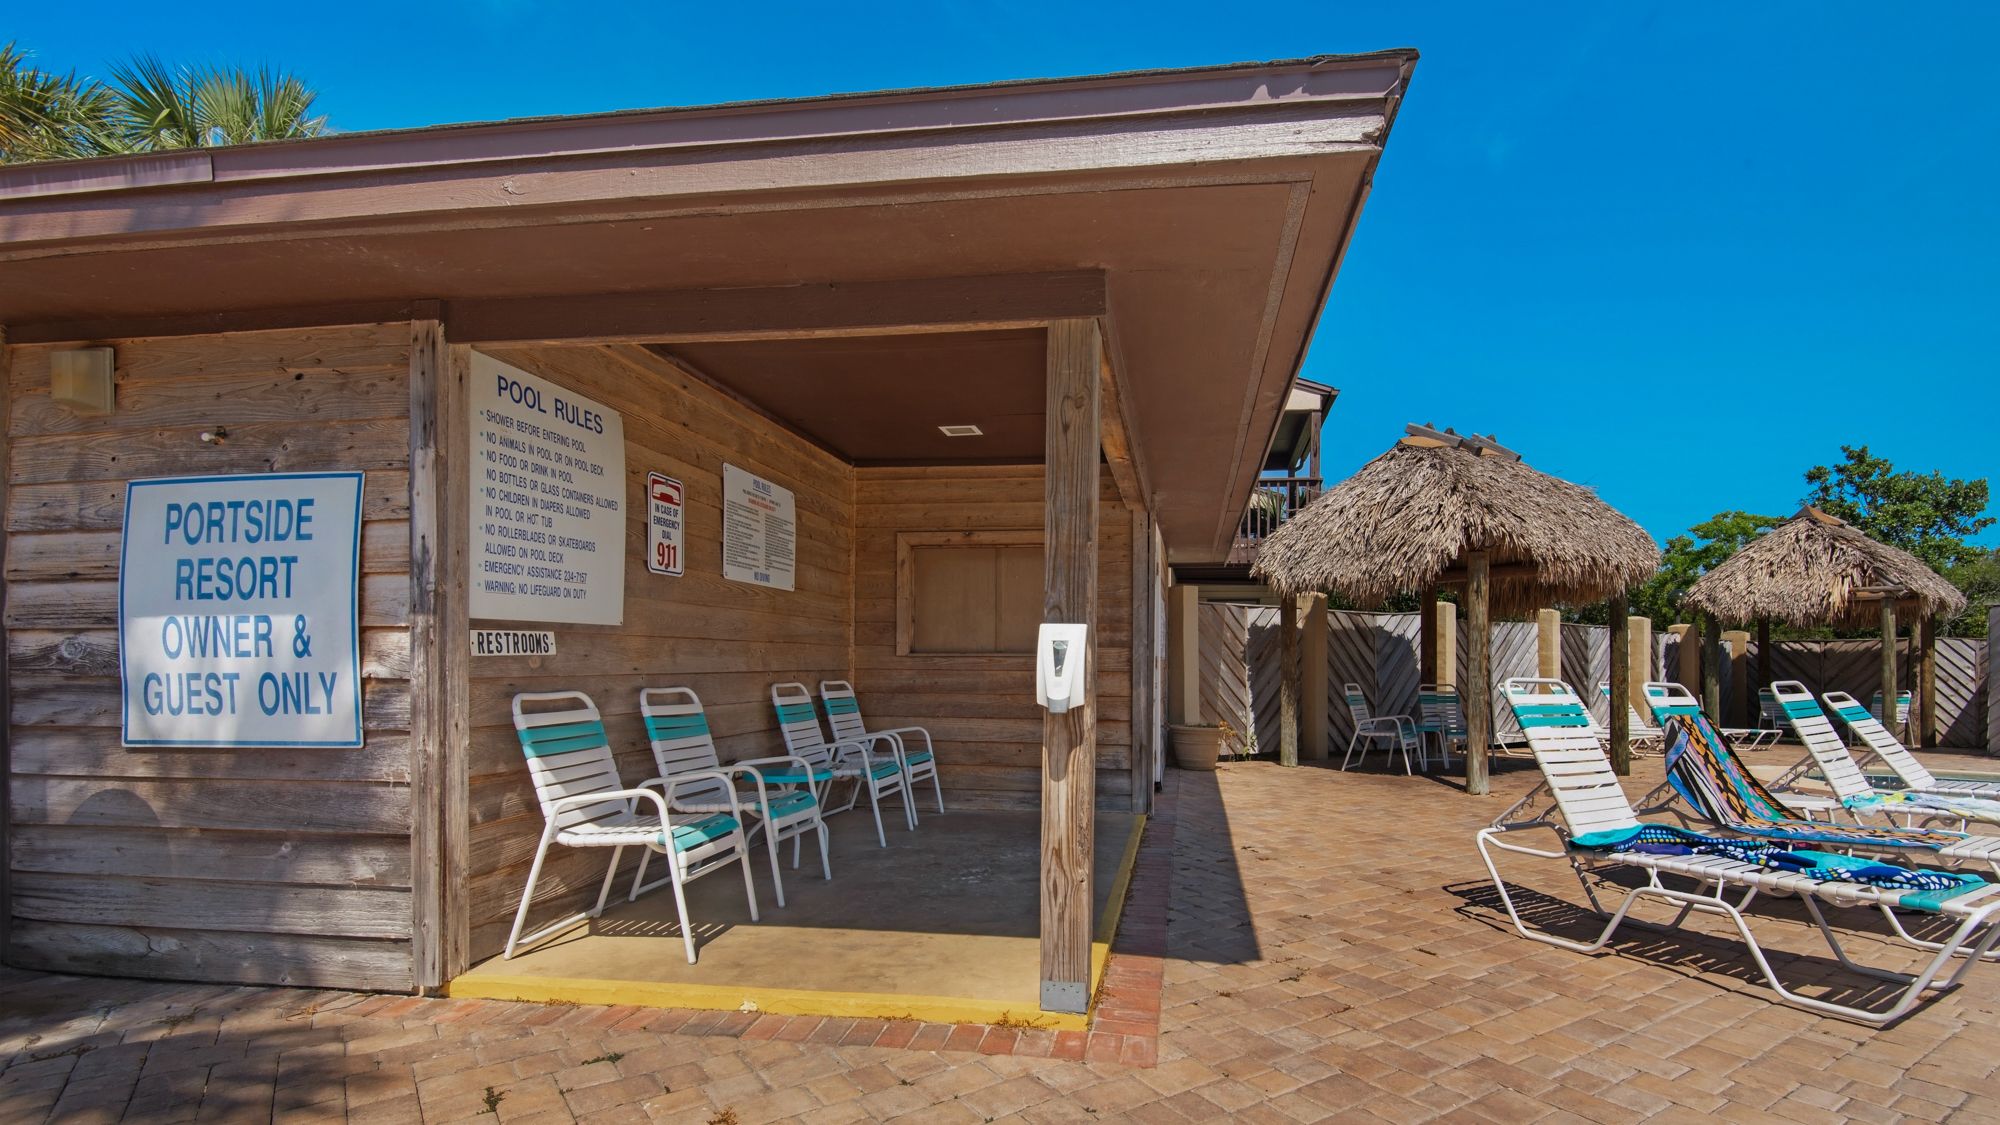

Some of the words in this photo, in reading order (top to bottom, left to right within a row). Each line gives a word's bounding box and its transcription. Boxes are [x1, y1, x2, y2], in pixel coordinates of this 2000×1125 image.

[497, 375, 546, 414] POOL
[554, 398, 603, 434] RULES
[486, 410, 514, 430] SHOWER
[516, 420, 540, 438] BEFORE
[542, 429, 570, 448] ENTERING
[572, 439, 586, 452] POOL
[486, 432, 496, 444] NO
[499, 436, 526, 454] ANIMALS
[528, 444, 534, 455] IN
[536, 446, 552, 462] POOL
[554, 452, 562, 465] OR
[565, 456, 573, 468] ON
[574, 458, 588, 472] POOL
[590, 464, 604, 477] DECK
[486, 450, 496, 462] NO
[500, 453, 517, 468] FOOD
[520, 459, 528, 470] OR
[531, 462, 548, 476] DRINK
[550, 468, 556, 479] IN
[558, 470, 574, 484] POOL
[486, 468, 496, 481] NO
[500, 472, 528, 488] BOTTLES
[530, 480, 538, 490] OR
[541, 482, 560, 497] GLASS
[562, 488, 594, 504] CONTAINERS
[596, 497, 618, 510] ALLOWED
[486, 487, 496, 500] NO
[499, 490, 530, 507] CHILDREN
[532, 498, 538, 508] IN
[540, 499, 564, 514] DIAPERS
[566, 506, 590, 520] ALLOWED
[164, 498, 314, 545] PORTSIDE
[486, 505, 492, 516] IN
[496, 508, 512, 520] POOL
[516, 511, 524, 522] OR
[527, 513, 538, 525] HOT
[542, 516, 552, 528] TUB
[654, 503, 660, 512] IN
[661, 506, 672, 516] CASE
[673, 508, 678, 518] OF
[654, 516, 680, 530] EMERGENCY
[486, 524, 495, 536] NO
[498, 526, 546, 544] ROLLERBLADES
[548, 534, 556, 545] OR
[558, 536, 596, 552] SKATEBOARDS
[662, 530, 672, 540] DIAL
[485, 542, 516, 558] ALLOWED
[519, 547, 528, 558] ON
[530, 548, 546, 561] POOL
[549, 552, 564, 564] DECK
[658, 542, 676, 568] 911
[176, 556, 298, 600] RESORT
[484, 560, 524, 576] EMERGENCY
[527, 568, 562, 580] ASSISTANCE
[485, 580, 516, 593] WARNING:
[518, 584, 528, 594] NO
[530, 585, 561, 597] LIFEGUARD
[564, 588, 571, 598] ON
[573, 588, 586, 600] DUTY
[162, 615, 273, 659] OWNER
[292, 614, 312, 658] &
[477, 632, 549, 654] RESTROOMS
[144, 672, 240, 716] GUEST
[258, 672, 337, 716] ONLY
